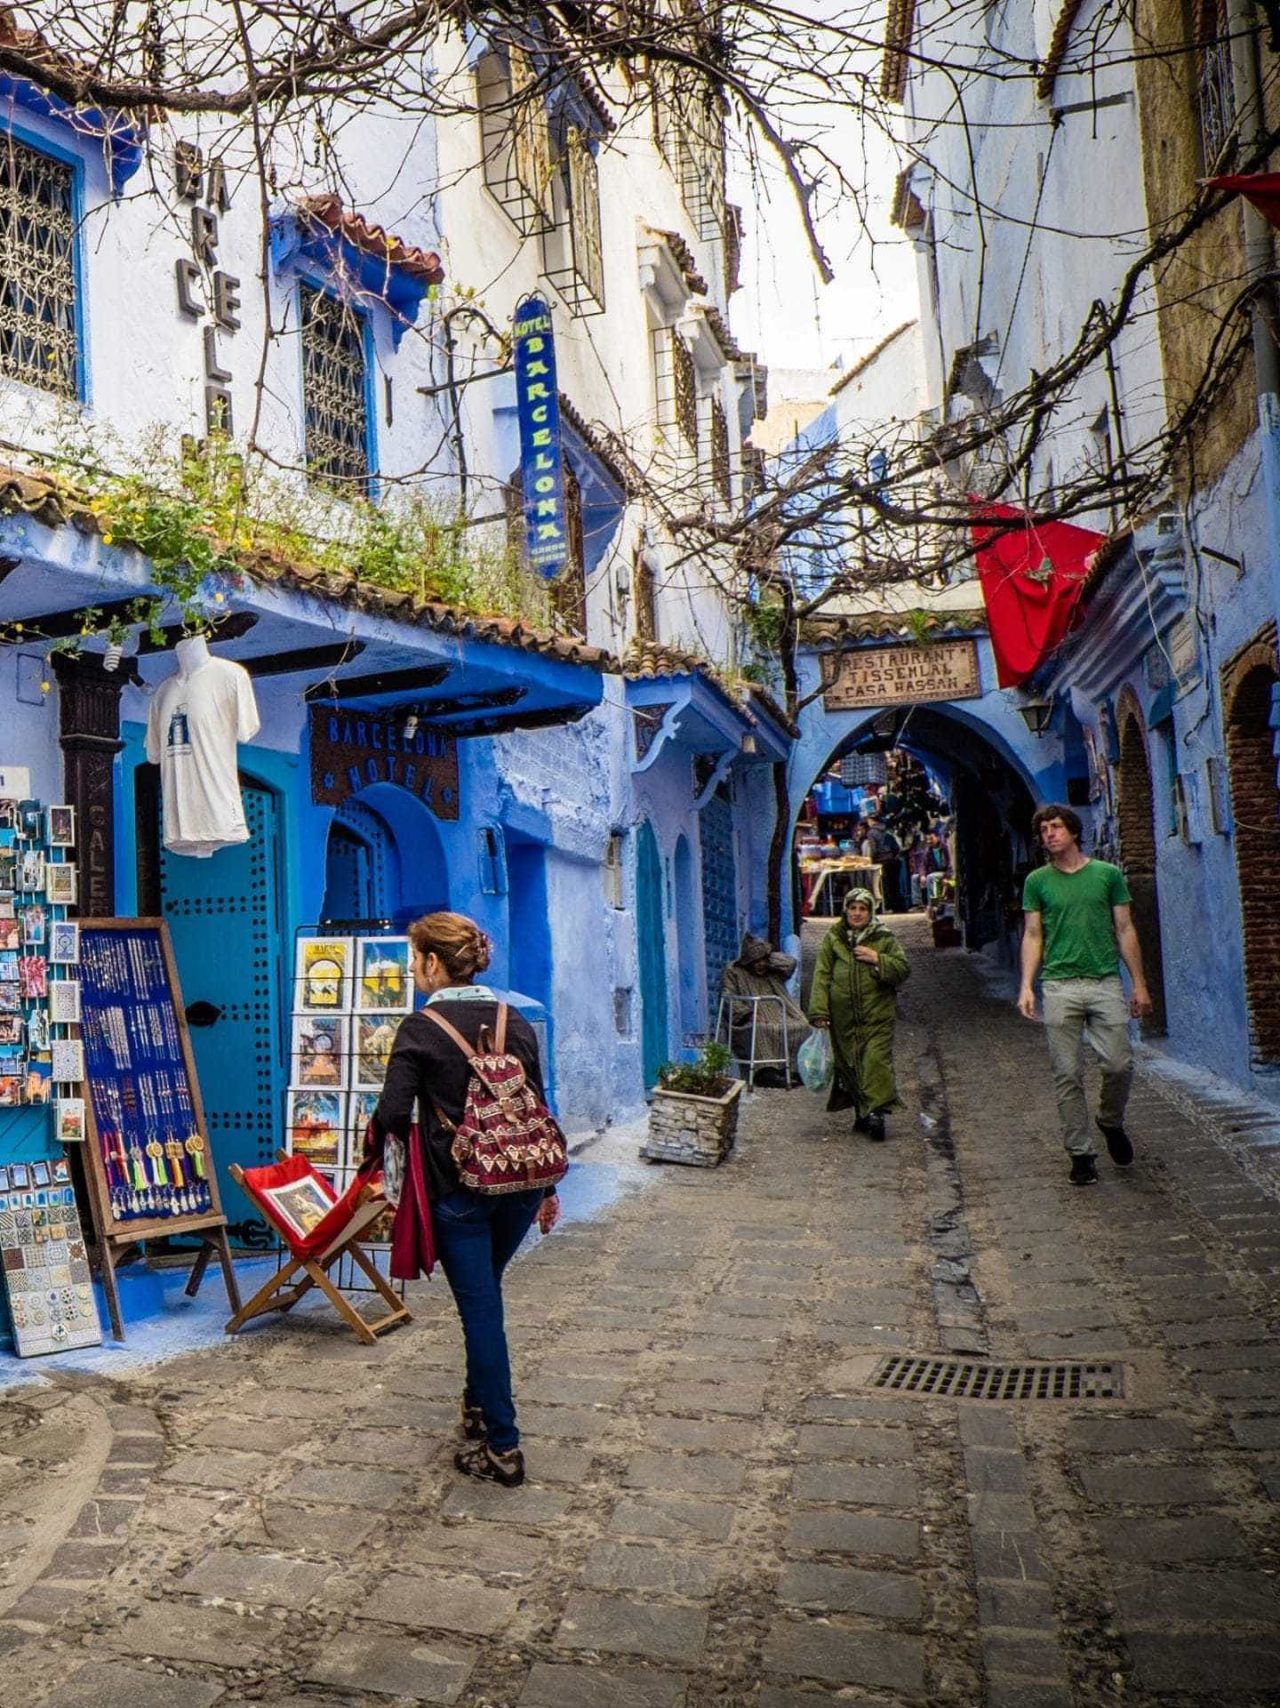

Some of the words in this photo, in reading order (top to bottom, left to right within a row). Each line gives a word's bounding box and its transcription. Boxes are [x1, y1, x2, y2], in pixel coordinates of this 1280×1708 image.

[513, 315, 551, 337] HOTEL
[525, 336, 562, 541] BARCELONA
[841, 649, 955, 672] RESTAURANT
[848, 663, 953, 684] TISSEMLAL
[845, 683, 888, 698] CASA
[895, 676, 958, 693] HASSAN
[347, 756, 433, 807] HOTEL
